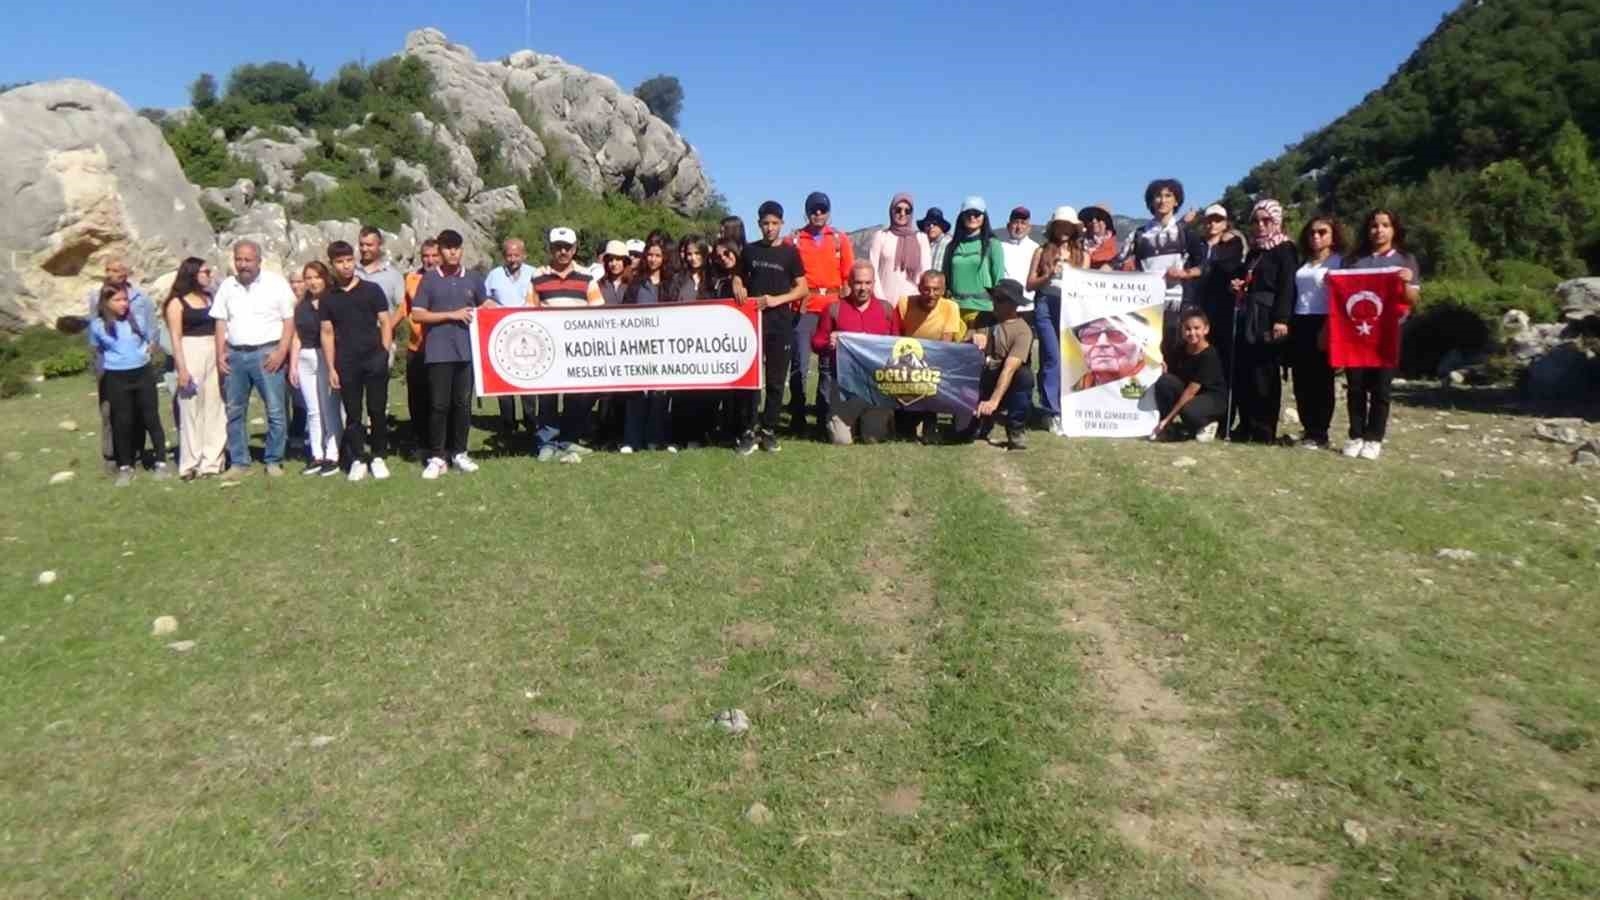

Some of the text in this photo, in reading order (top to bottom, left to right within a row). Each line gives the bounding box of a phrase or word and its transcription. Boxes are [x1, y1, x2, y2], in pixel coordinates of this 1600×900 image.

[563, 315, 660, 330] OSMANİYE-KADİRLİ
[564, 332, 748, 357] KADİRLİ AHMET TOPALOĞLU
[567, 359, 739, 378] MESLEKİ VE TEKNİK ANADOLU LİSESİ
